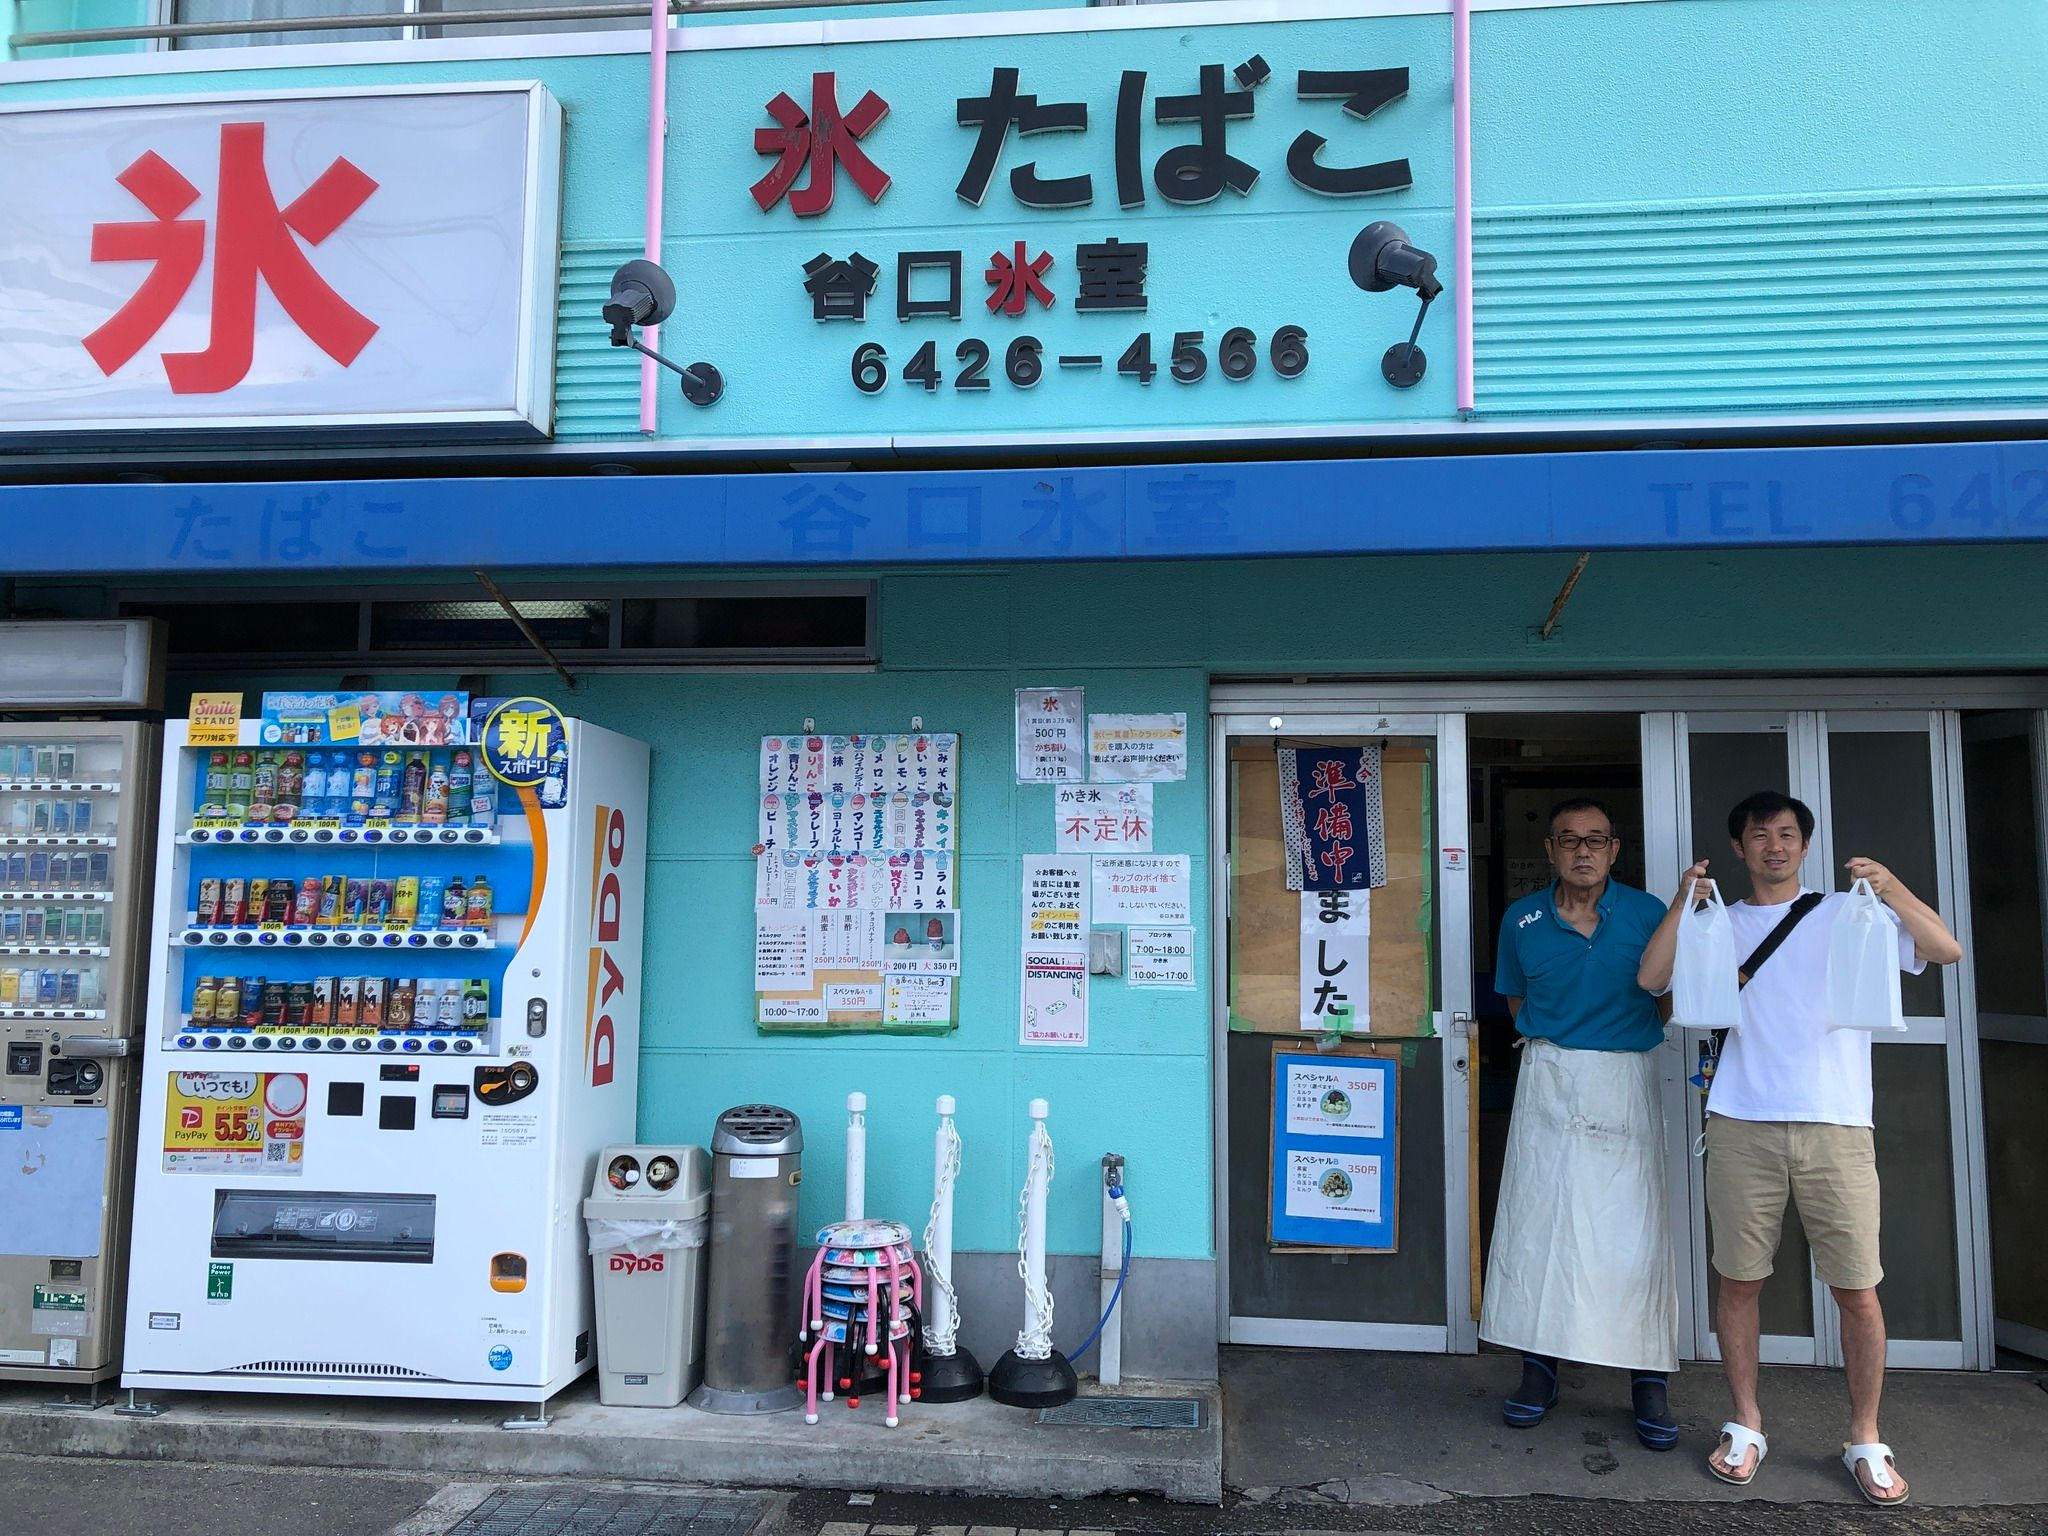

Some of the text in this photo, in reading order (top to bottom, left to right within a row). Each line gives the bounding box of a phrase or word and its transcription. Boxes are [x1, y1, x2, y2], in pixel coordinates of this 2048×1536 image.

[750, 54, 1412, 217] 氷 たばこ
[82, 122, 380, 394] 氷
[802, 237, 1149, 323] 谷口氷室
[169, 492, 408, 561] たばこ
[778, 473, 1239, 555] 谷口氷室
[1648, 480, 1813, 538] TEL
[195, 698, 236, 716] Smile
[1042, 696, 1058, 712] 氷
[194, 717, 235, 726] STAND
[497, 709, 551, 758] 新
[190, 733, 226, 742] アプリ対応
[499, 760, 547, 774] スポドリ
[768, 753, 779, 792] オレンジ
[787, 753, 800, 792] 青りんご
[806, 756, 818, 792] りんご
[873, 753, 884, 792] メロン
[917, 753, 928, 792] いちご
[937, 753, 949, 792] みぞれ
[1061, 789, 1101, 802] かき氷
[765, 811, 777, 850] ピーチ
[809, 811, 821, 849] グレープ
[831, 812, 842, 850] ヨーグルト
[852, 812, 864, 850] マンゴー
[936, 808, 949, 849] キウイ
[1065, 815, 1148, 842] 不定休
[1308, 760, 1356, 883] 準備中
[1095, 860, 1181, 868] ご近所迷惑になりますので
[828, 868, 842, 908] すいか
[914, 871, 925, 910] コーラ
[935, 871, 947, 910] ラムネ
[1032, 880, 1080, 888] 当店には駐車
[1032, 891, 1080, 899] 場がございませ
[1519, 910, 1543, 929] FILA
[592, 809, 625, 1088] DYDO
[814, 956, 835, 964] 250円
[838, 956, 859, 964] 250円
[1028, 956, 1060, 965] SOCIAL
[1314, 890, 1350, 1016] ました
[861, 960, 882, 968] 250円
[1028, 970, 1083, 980] DISTANCING
[841, 997, 866, 1006] 350円
[193, 1081, 248, 1093] いつでも!
[1294, 1073, 1377, 1092] スペシャルA 350円
[175, 1131, 208, 1140] PayPay
[214, 1113, 261, 1142] 5.5%
[1294, 1155, 1378, 1175] スペシャルB 350円
[610, 1257, 664, 1275] DyDo
